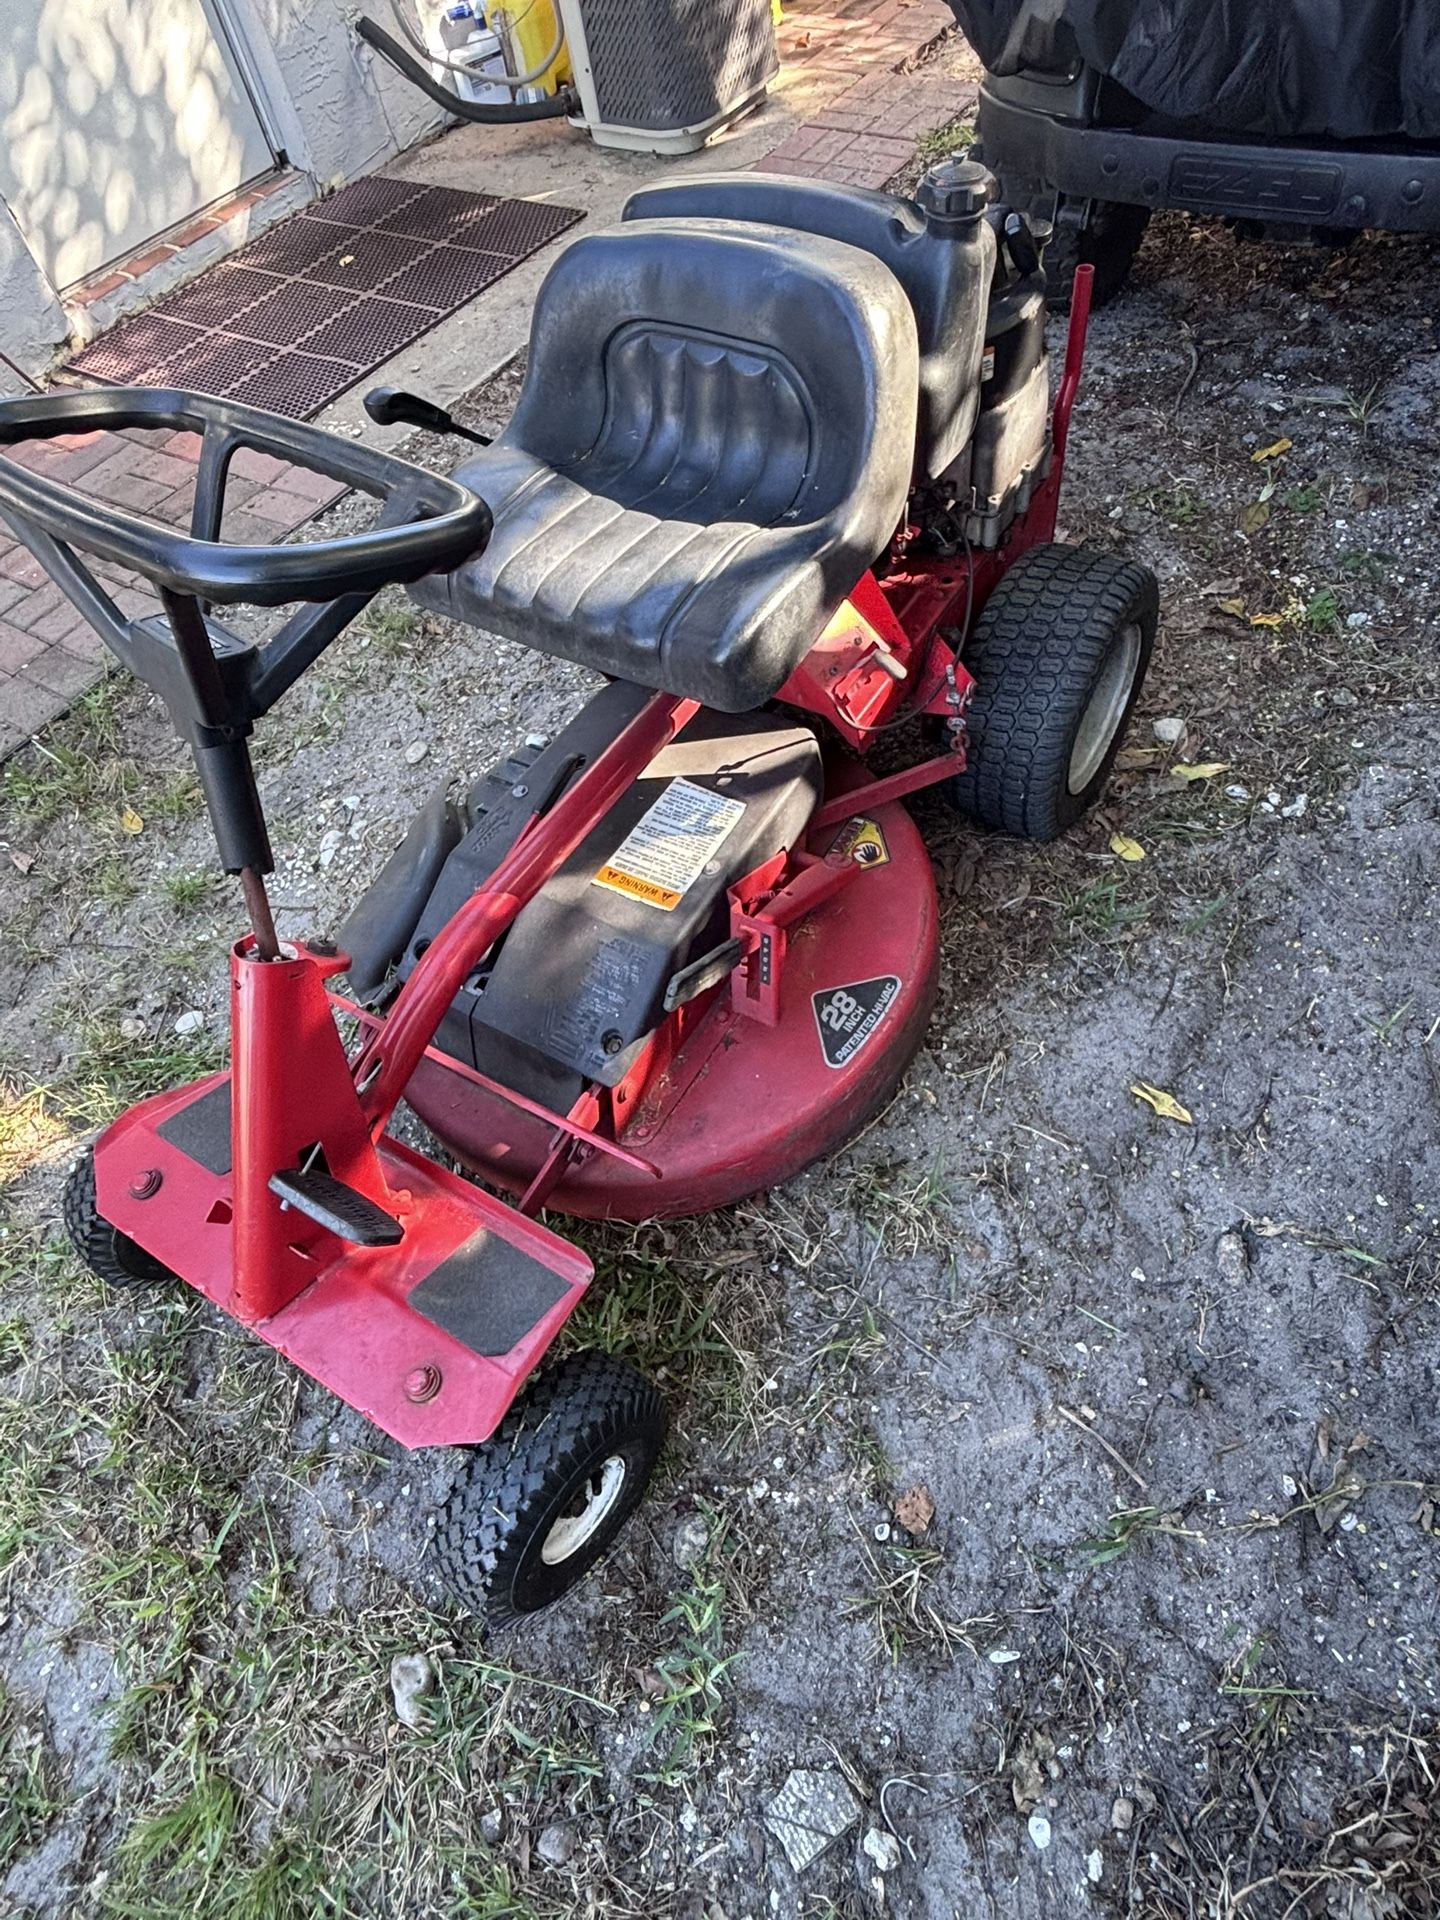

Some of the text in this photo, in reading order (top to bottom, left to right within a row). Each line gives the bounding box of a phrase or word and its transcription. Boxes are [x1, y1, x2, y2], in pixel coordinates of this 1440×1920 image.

[619, 875, 659, 897] WARNING
[820, 990, 857, 1032] 28
[836, 982, 896, 1061] PATENTED HI-VAC
[843, 1005, 866, 1033] INCH
